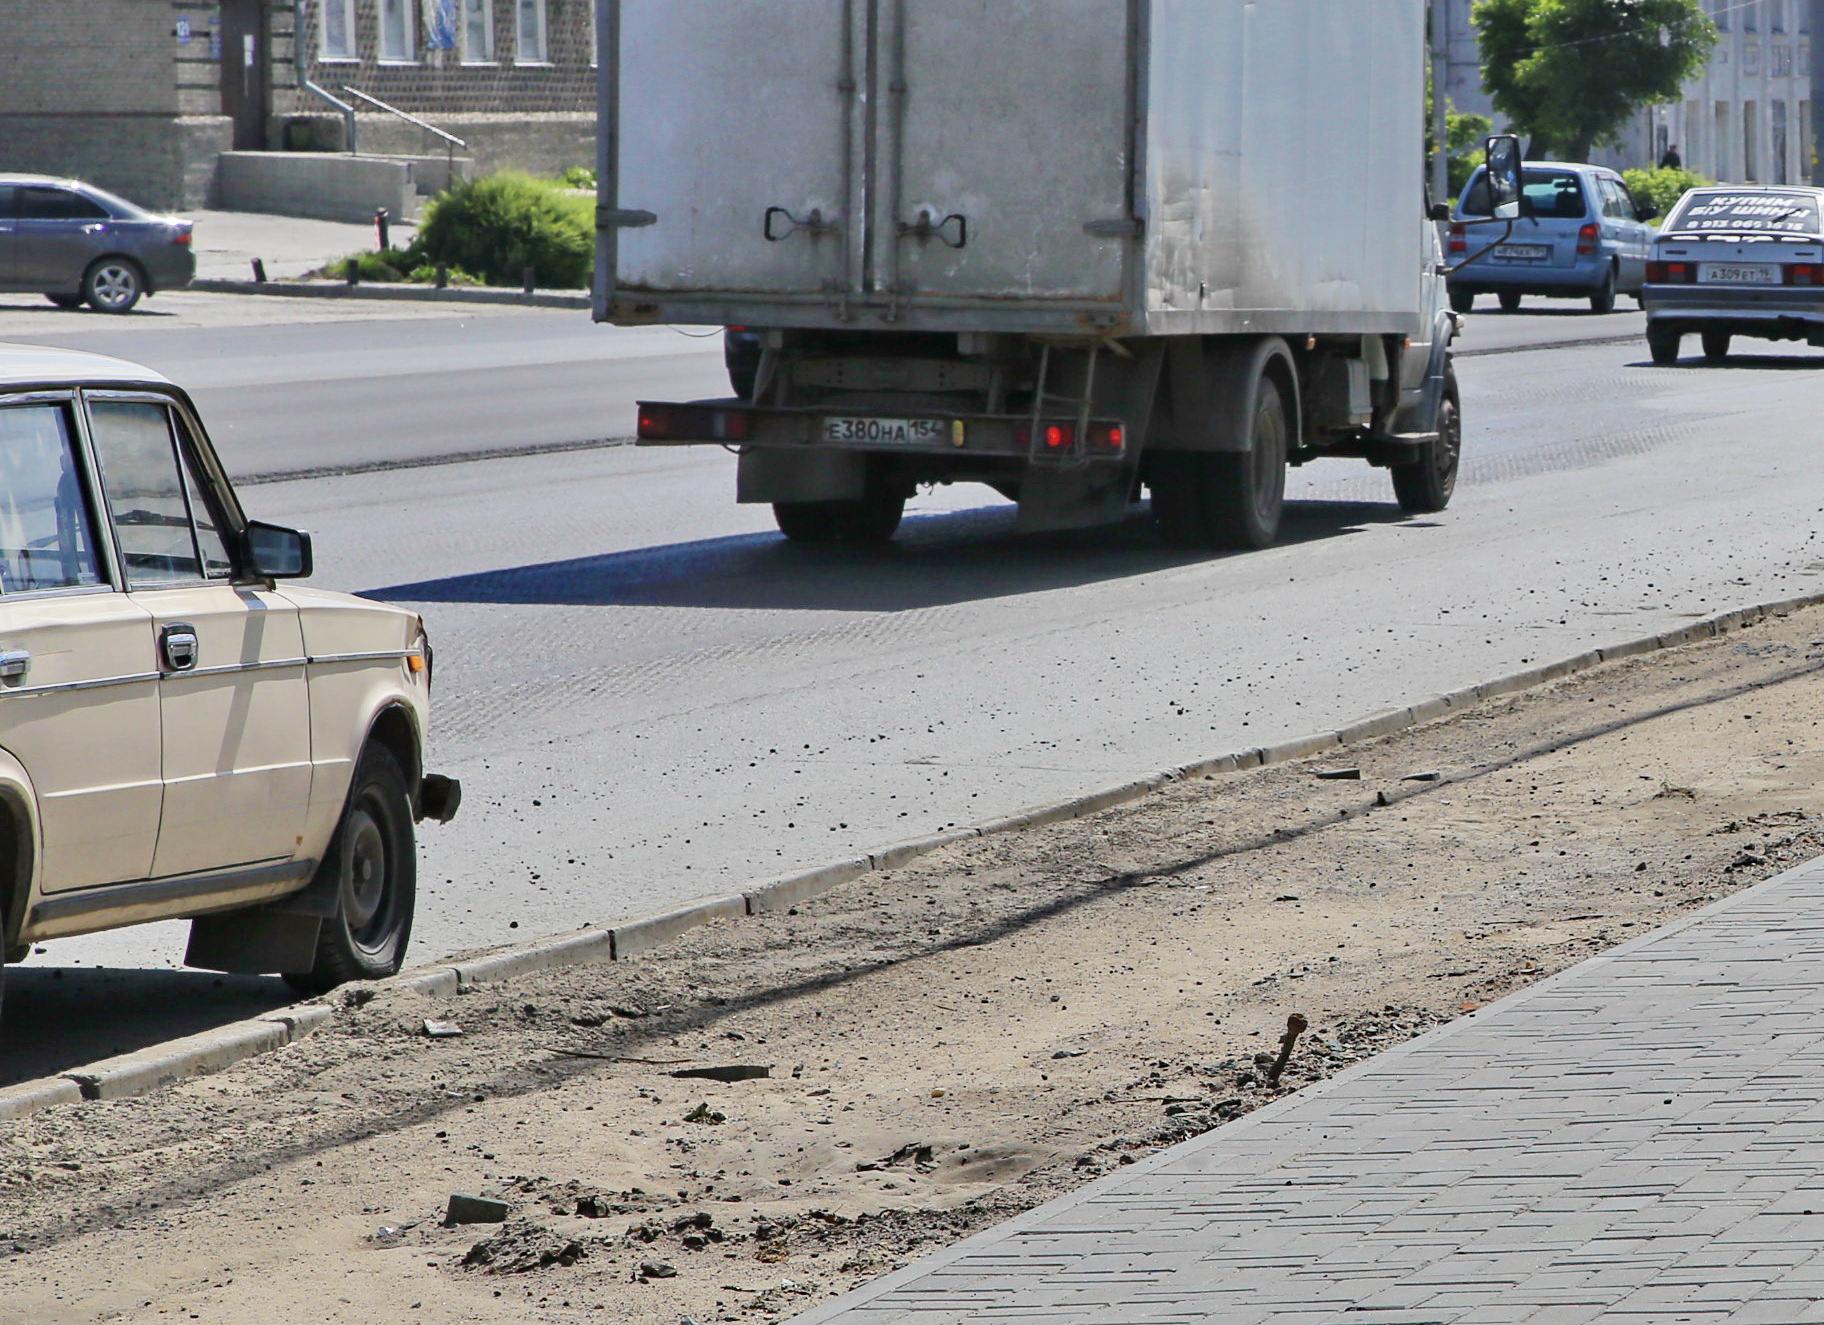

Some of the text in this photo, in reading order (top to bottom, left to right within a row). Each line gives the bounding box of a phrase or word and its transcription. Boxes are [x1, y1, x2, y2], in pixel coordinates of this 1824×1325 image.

[1709, 196, 1796, 207] КУПИМ
[1730, 205, 1811, 218] ШИНЫ
[1701, 219, 1729, 229] 913
[830, 419, 907, 441] Е380НА
